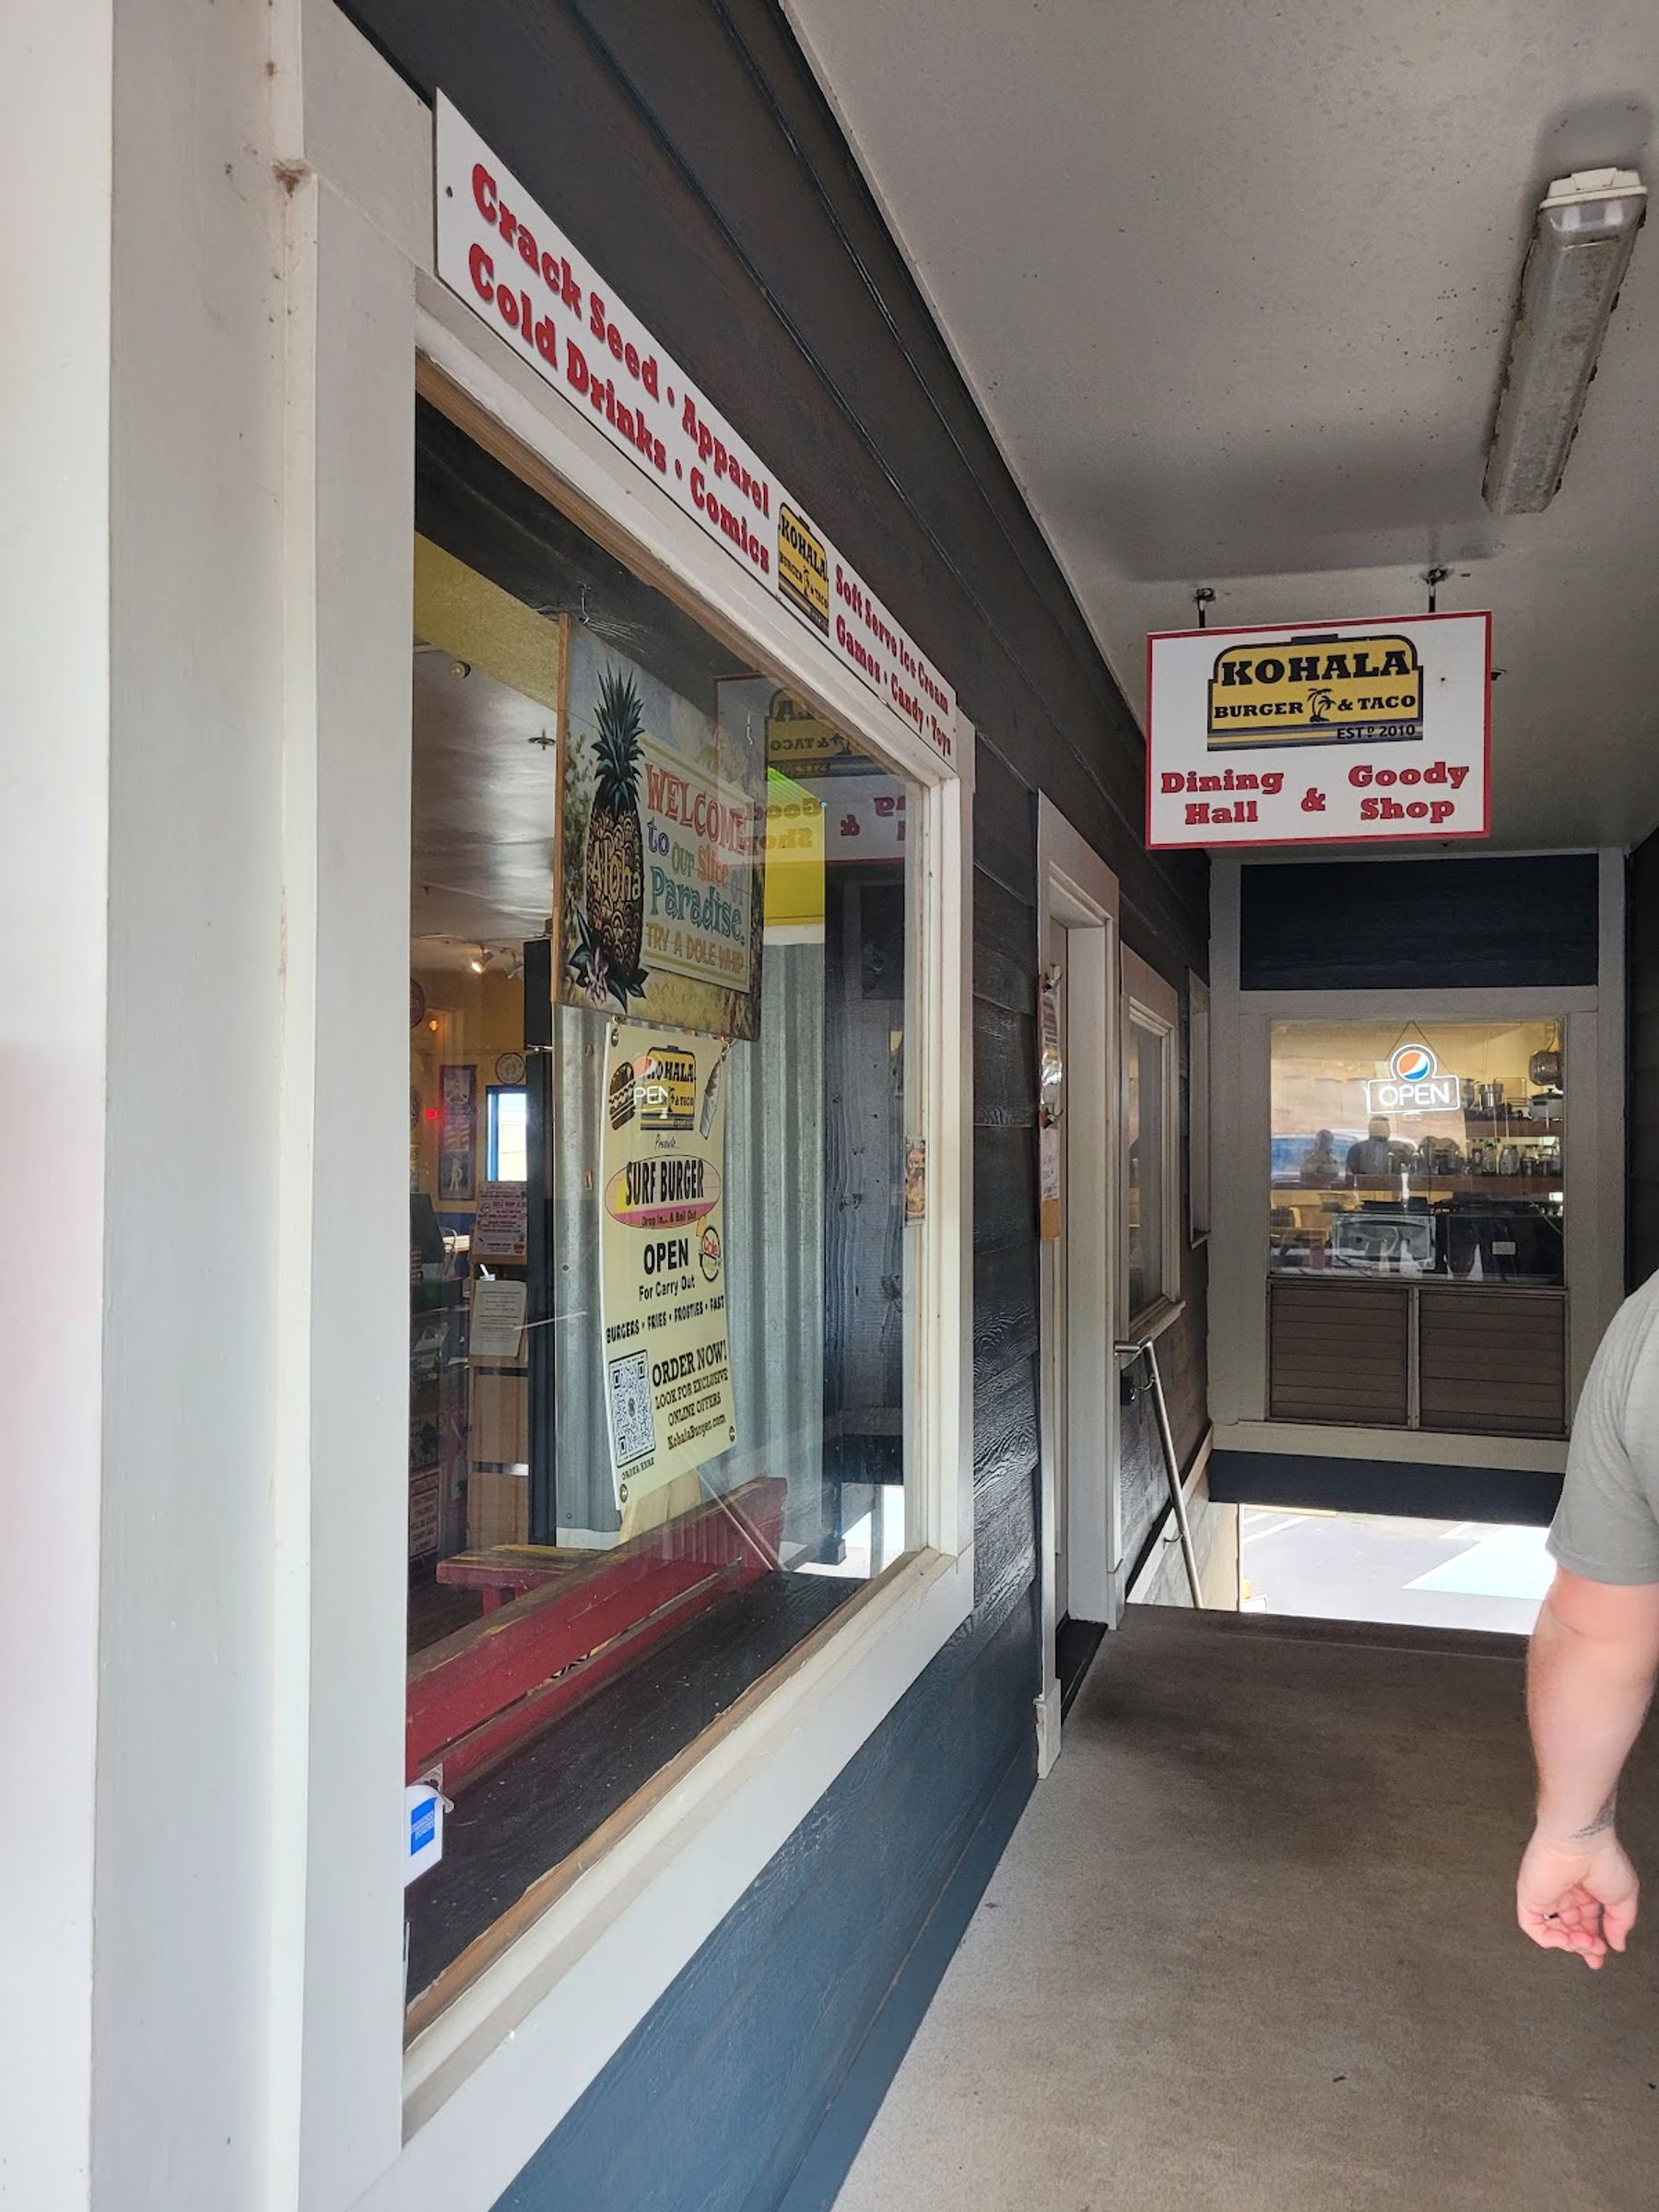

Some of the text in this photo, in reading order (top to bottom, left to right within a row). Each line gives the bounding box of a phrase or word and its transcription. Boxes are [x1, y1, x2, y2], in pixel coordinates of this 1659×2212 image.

[472, 163, 770, 520] Crack Seed Apparel
[468, 243, 770, 574] Cold Drinks Comics
[781, 513, 829, 582] KOHALA
[836, 564, 949, 716] Soft Serve Ice Cream
[836, 614, 951, 757] Games Candy Toys
[1221, 650, 1411, 687] KOHALA
[1214, 694, 1416, 719] BURGER & TACO
[1379, 724, 1416, 738] 2010
[1161, 769, 1284, 795] Dining
[1347, 761, 1470, 790] Goody
[645, 762, 746, 856] WELCOME
[1184, 800, 1258, 825] Hall
[1300, 787, 1326, 811] &
[1360, 797, 1455, 824] Shop
[646, 817, 669, 856] to
[671, 841, 695, 877] our
[590, 840, 641, 902] Aloha
[646, 923, 745, 974] TRY A DOLE WHIP
[1378, 1082, 1451, 1108] OPEN
[625, 1159, 704, 1206] SURF BURGER
[641, 1216, 656, 1227] Drop
[643, 1238, 688, 1275] OPEN
[639, 1275, 696, 1301] For Carry Out
[606, 1319, 640, 1344] BURGERS
[647, 1311, 666, 1331] FRIES
[675, 1300, 703, 1323] FROSTIES
[652, 1339, 727, 1388] ORDER NOW!
[654, 1368, 728, 1410] LOOK FOR EXCLUSIVE
[667, 1392, 722, 1427] ONLINE OFFERS
